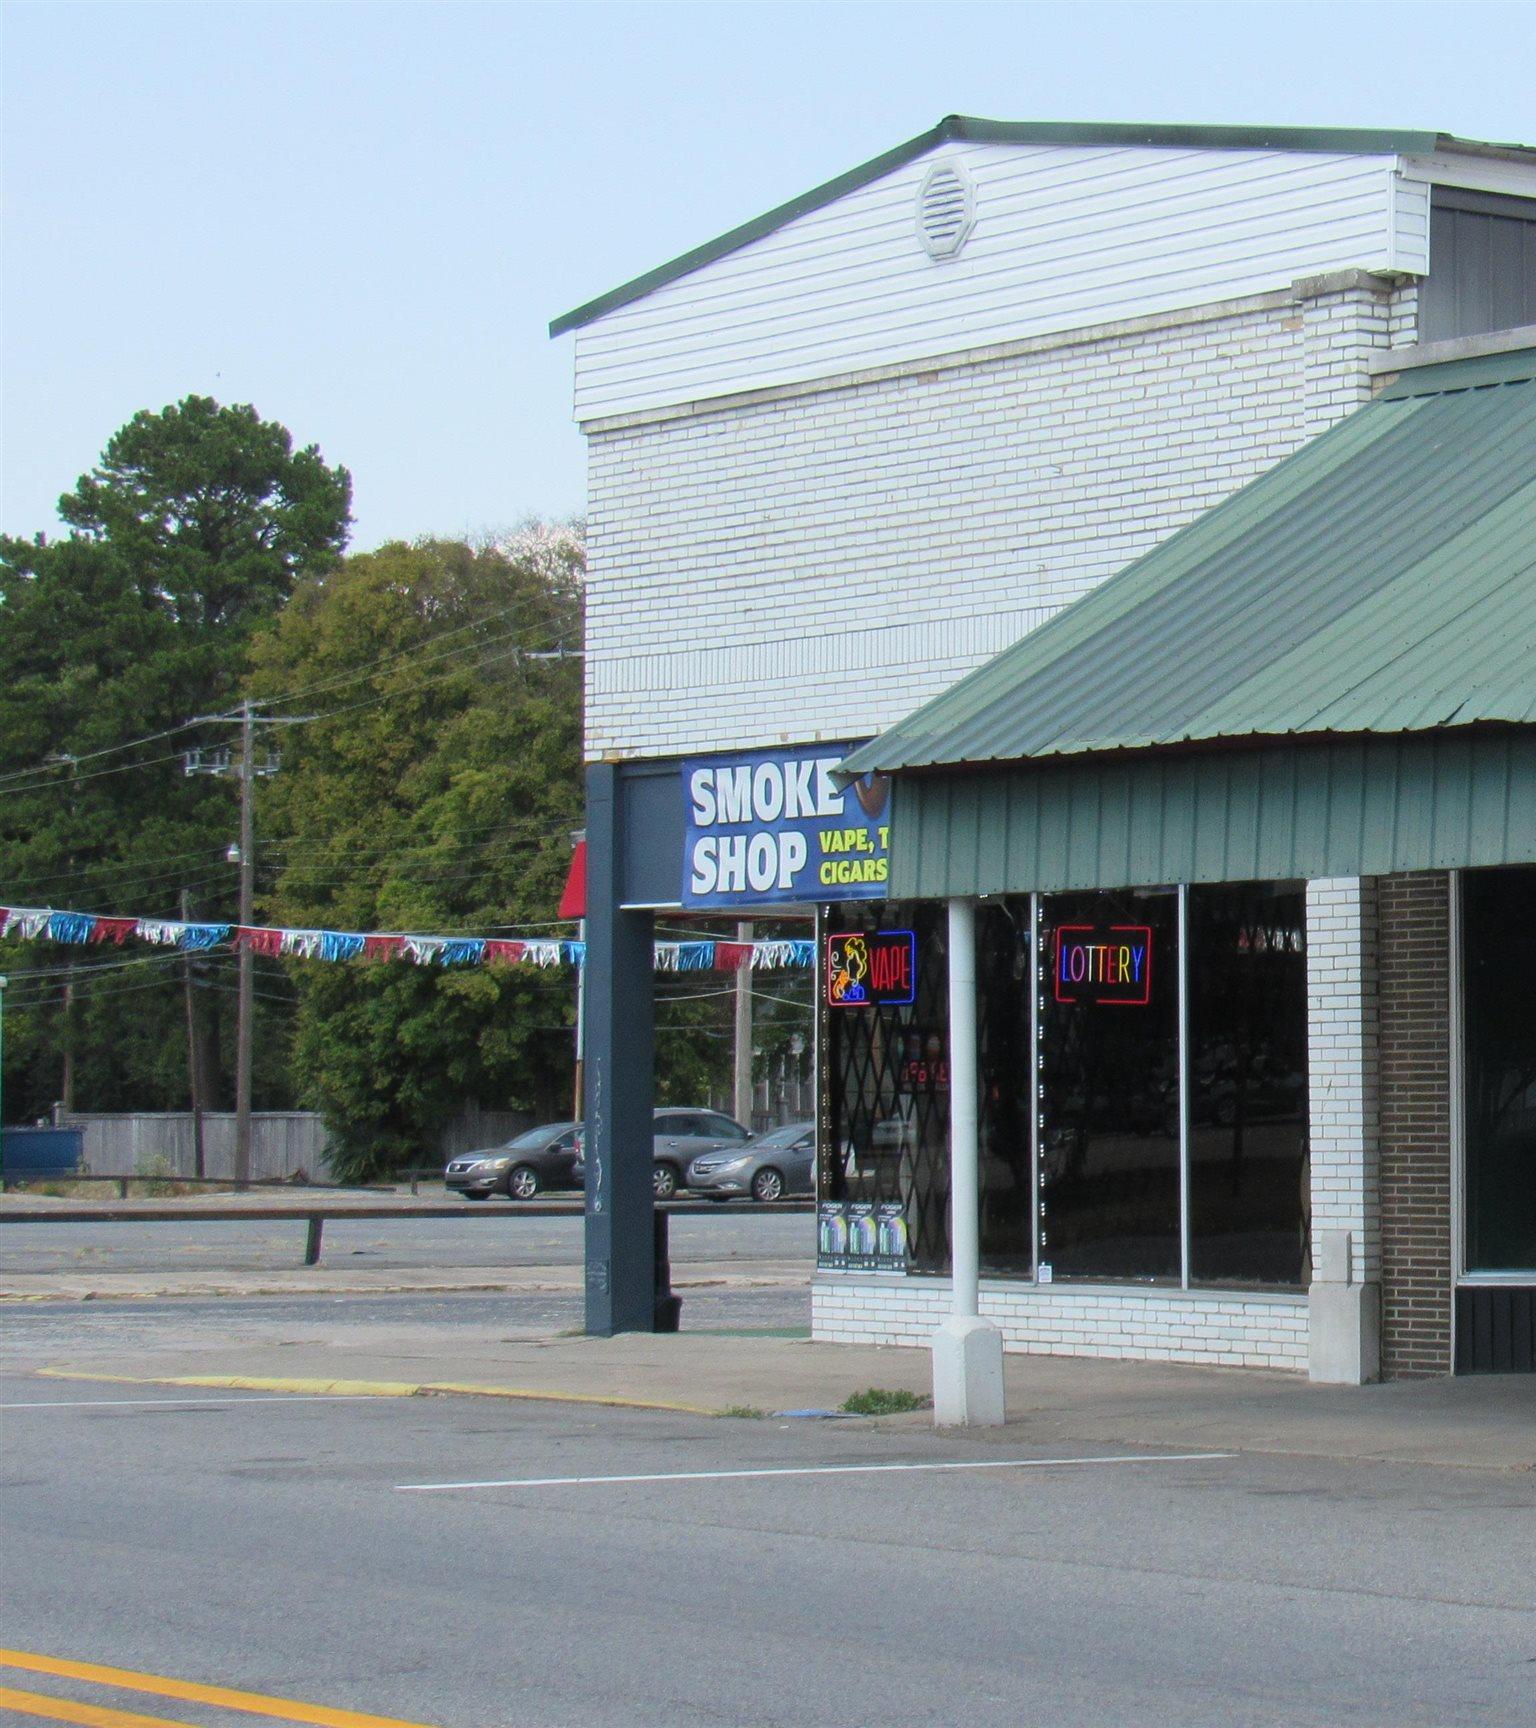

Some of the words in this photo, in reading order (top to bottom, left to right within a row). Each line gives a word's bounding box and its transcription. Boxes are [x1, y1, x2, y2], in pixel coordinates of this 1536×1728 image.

[690, 757, 845, 827] SMOKE
[819, 828, 875, 854] VAPE,
[691, 831, 808, 895] SHOP
[819, 857, 888, 885] CIGARS
[869, 946, 910, 990] VAPE
[1062, 945, 1144, 983] LOTTERY
